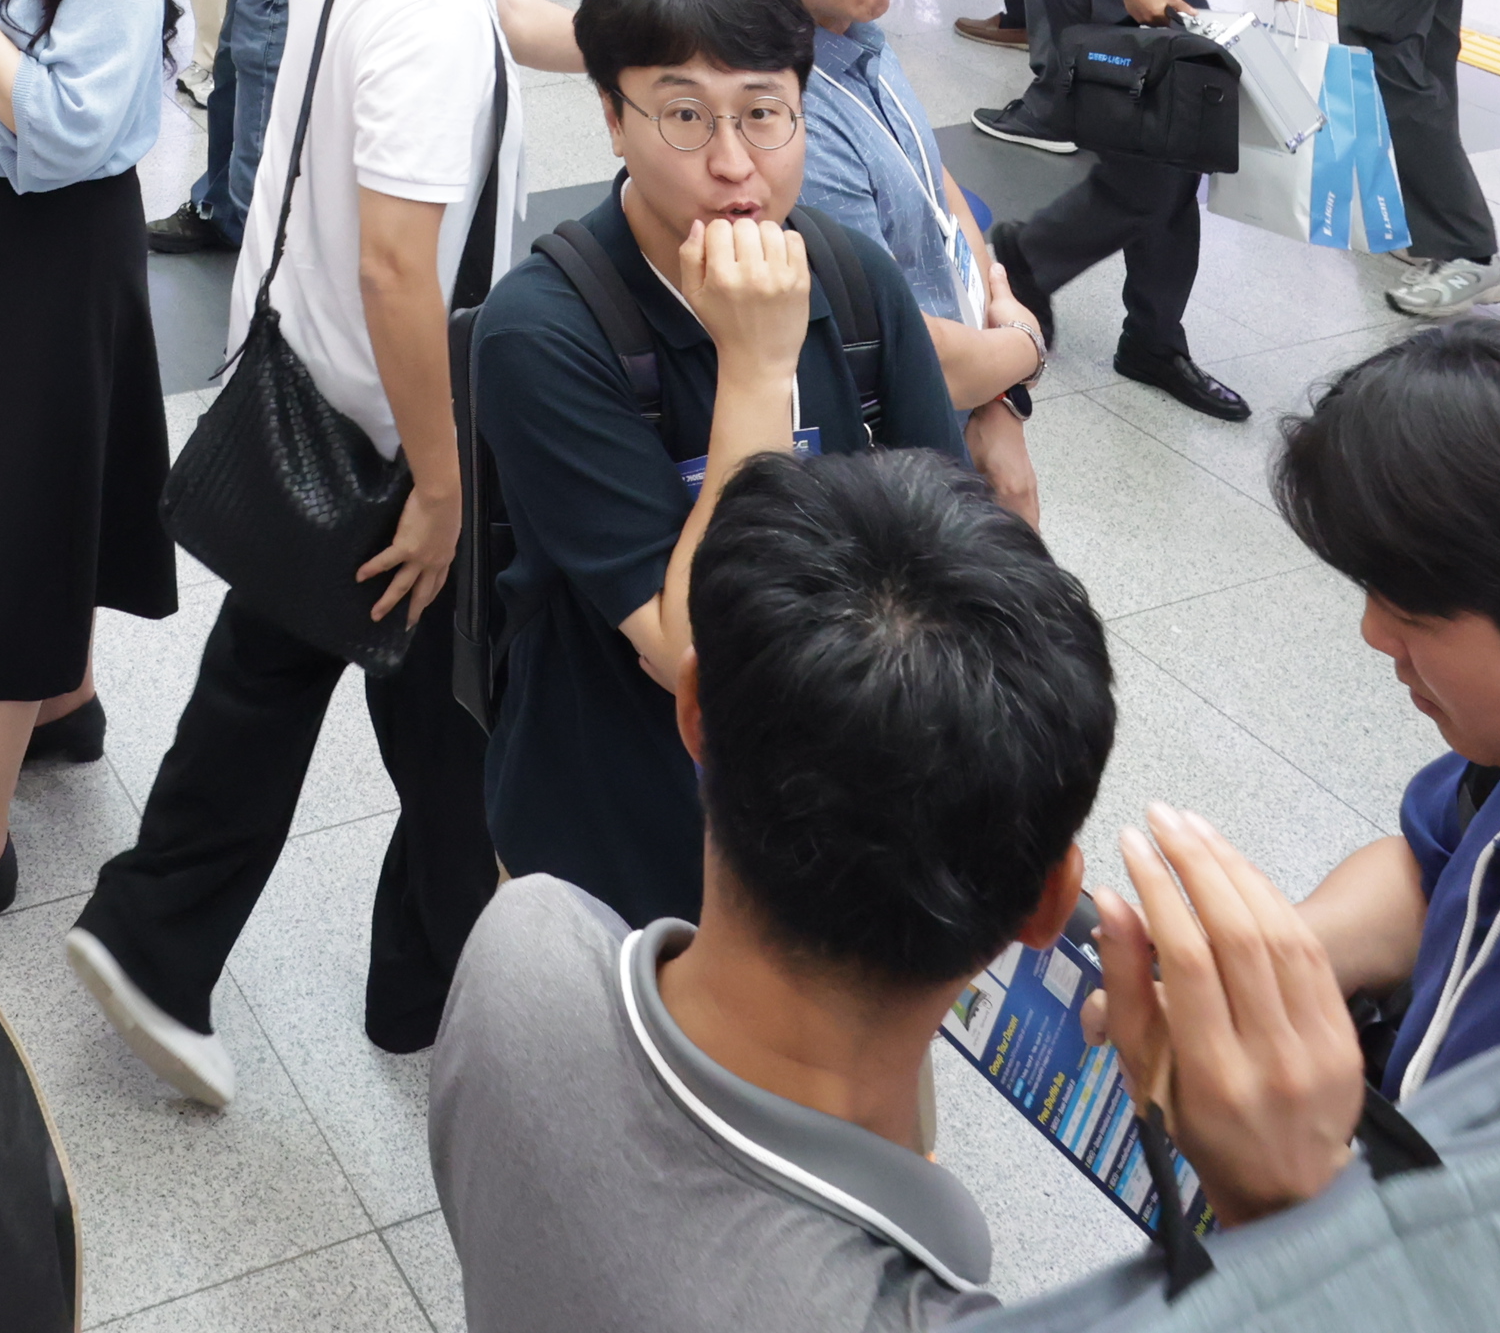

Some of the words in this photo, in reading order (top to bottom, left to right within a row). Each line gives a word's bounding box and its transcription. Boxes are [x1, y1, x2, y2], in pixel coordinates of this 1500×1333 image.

[1447, 275, 1470, 290] N
[987, 1050, 1005, 1077] Group
[997, 1036, 1011, 1058] Tour
[1037, 1100, 1051, 1125] Free
[1044, 1082, 1063, 1108] Shuttle
